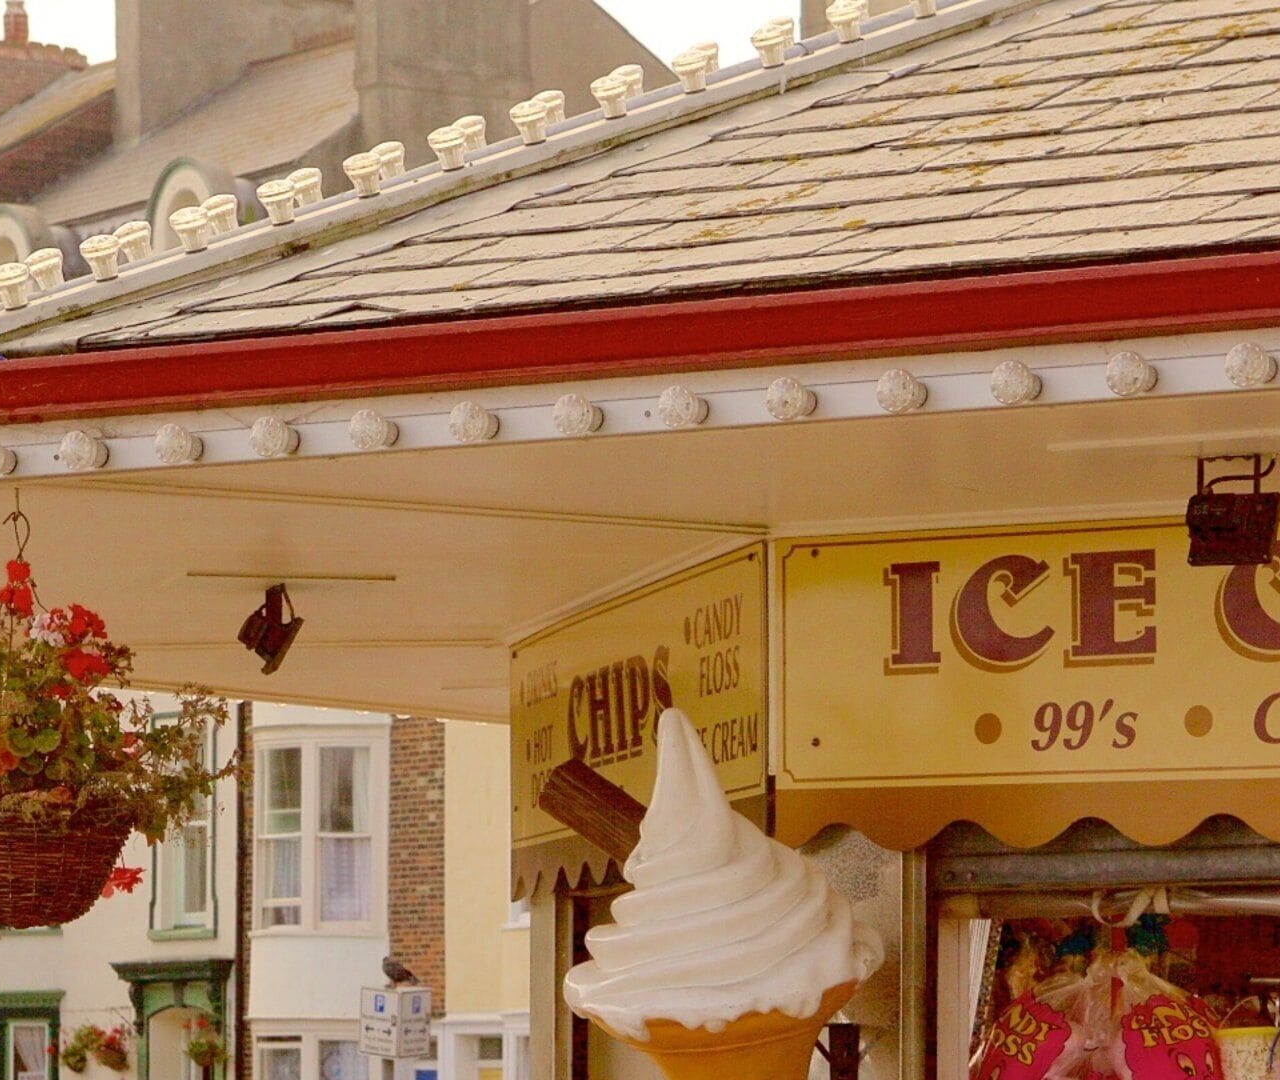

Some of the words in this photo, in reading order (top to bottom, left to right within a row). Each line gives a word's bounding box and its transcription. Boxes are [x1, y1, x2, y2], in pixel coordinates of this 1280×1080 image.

[693, 593, 743, 650] CANDY
[883, 549, 1157, 676] ICE
[699, 645, 740, 697] FLOSS
[568, 645, 673, 768] CHIPS
[1031, 697, 1139, 752] 99's
[711, 712, 758, 765] CREAM
